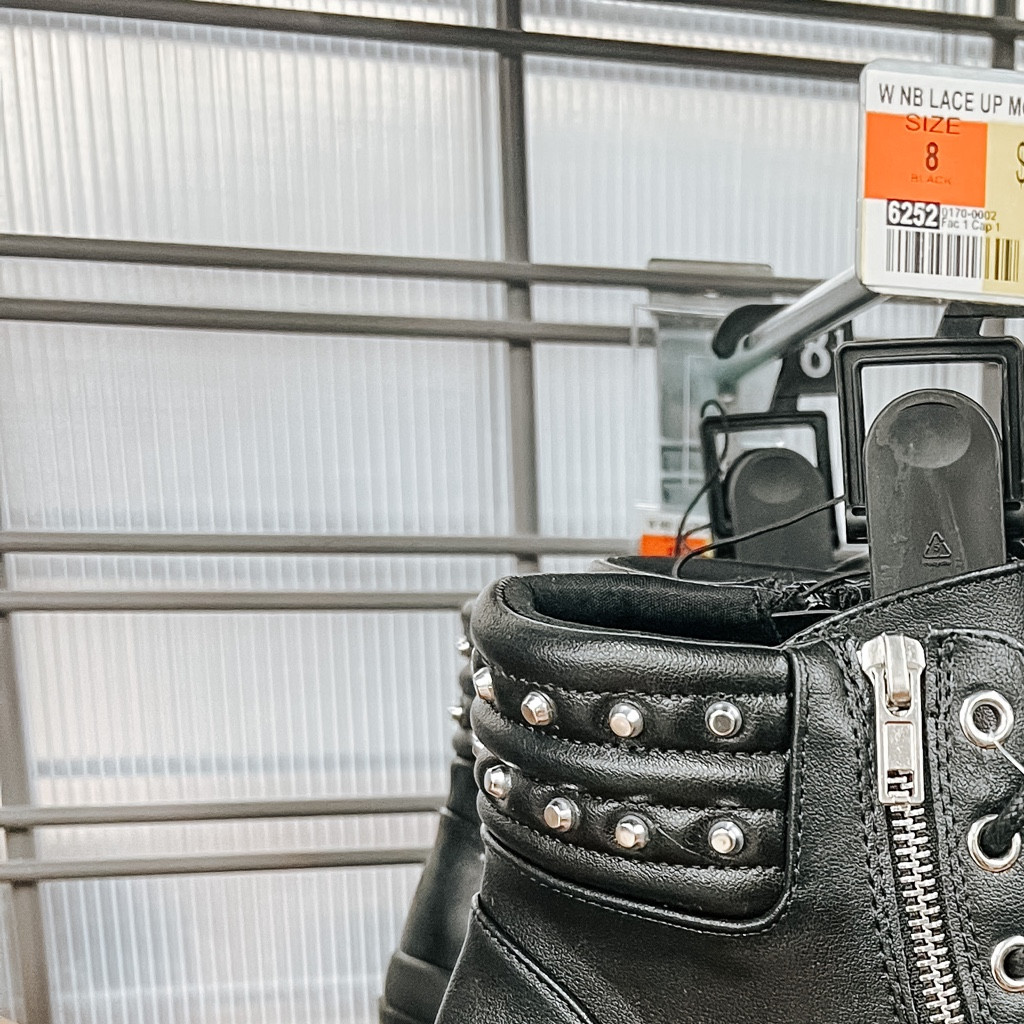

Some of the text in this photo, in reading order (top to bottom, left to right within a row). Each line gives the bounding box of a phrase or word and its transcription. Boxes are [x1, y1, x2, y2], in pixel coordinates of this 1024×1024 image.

[879, 83, 895, 104] W
[900, 86, 923, 107] NB
[930, 88, 974, 111] LACE
[980, 93, 1003, 114] UP
[905, 113, 960, 134] SIZE
[925, 141, 939, 171] 8
[887, 200, 939, 228] 6252
